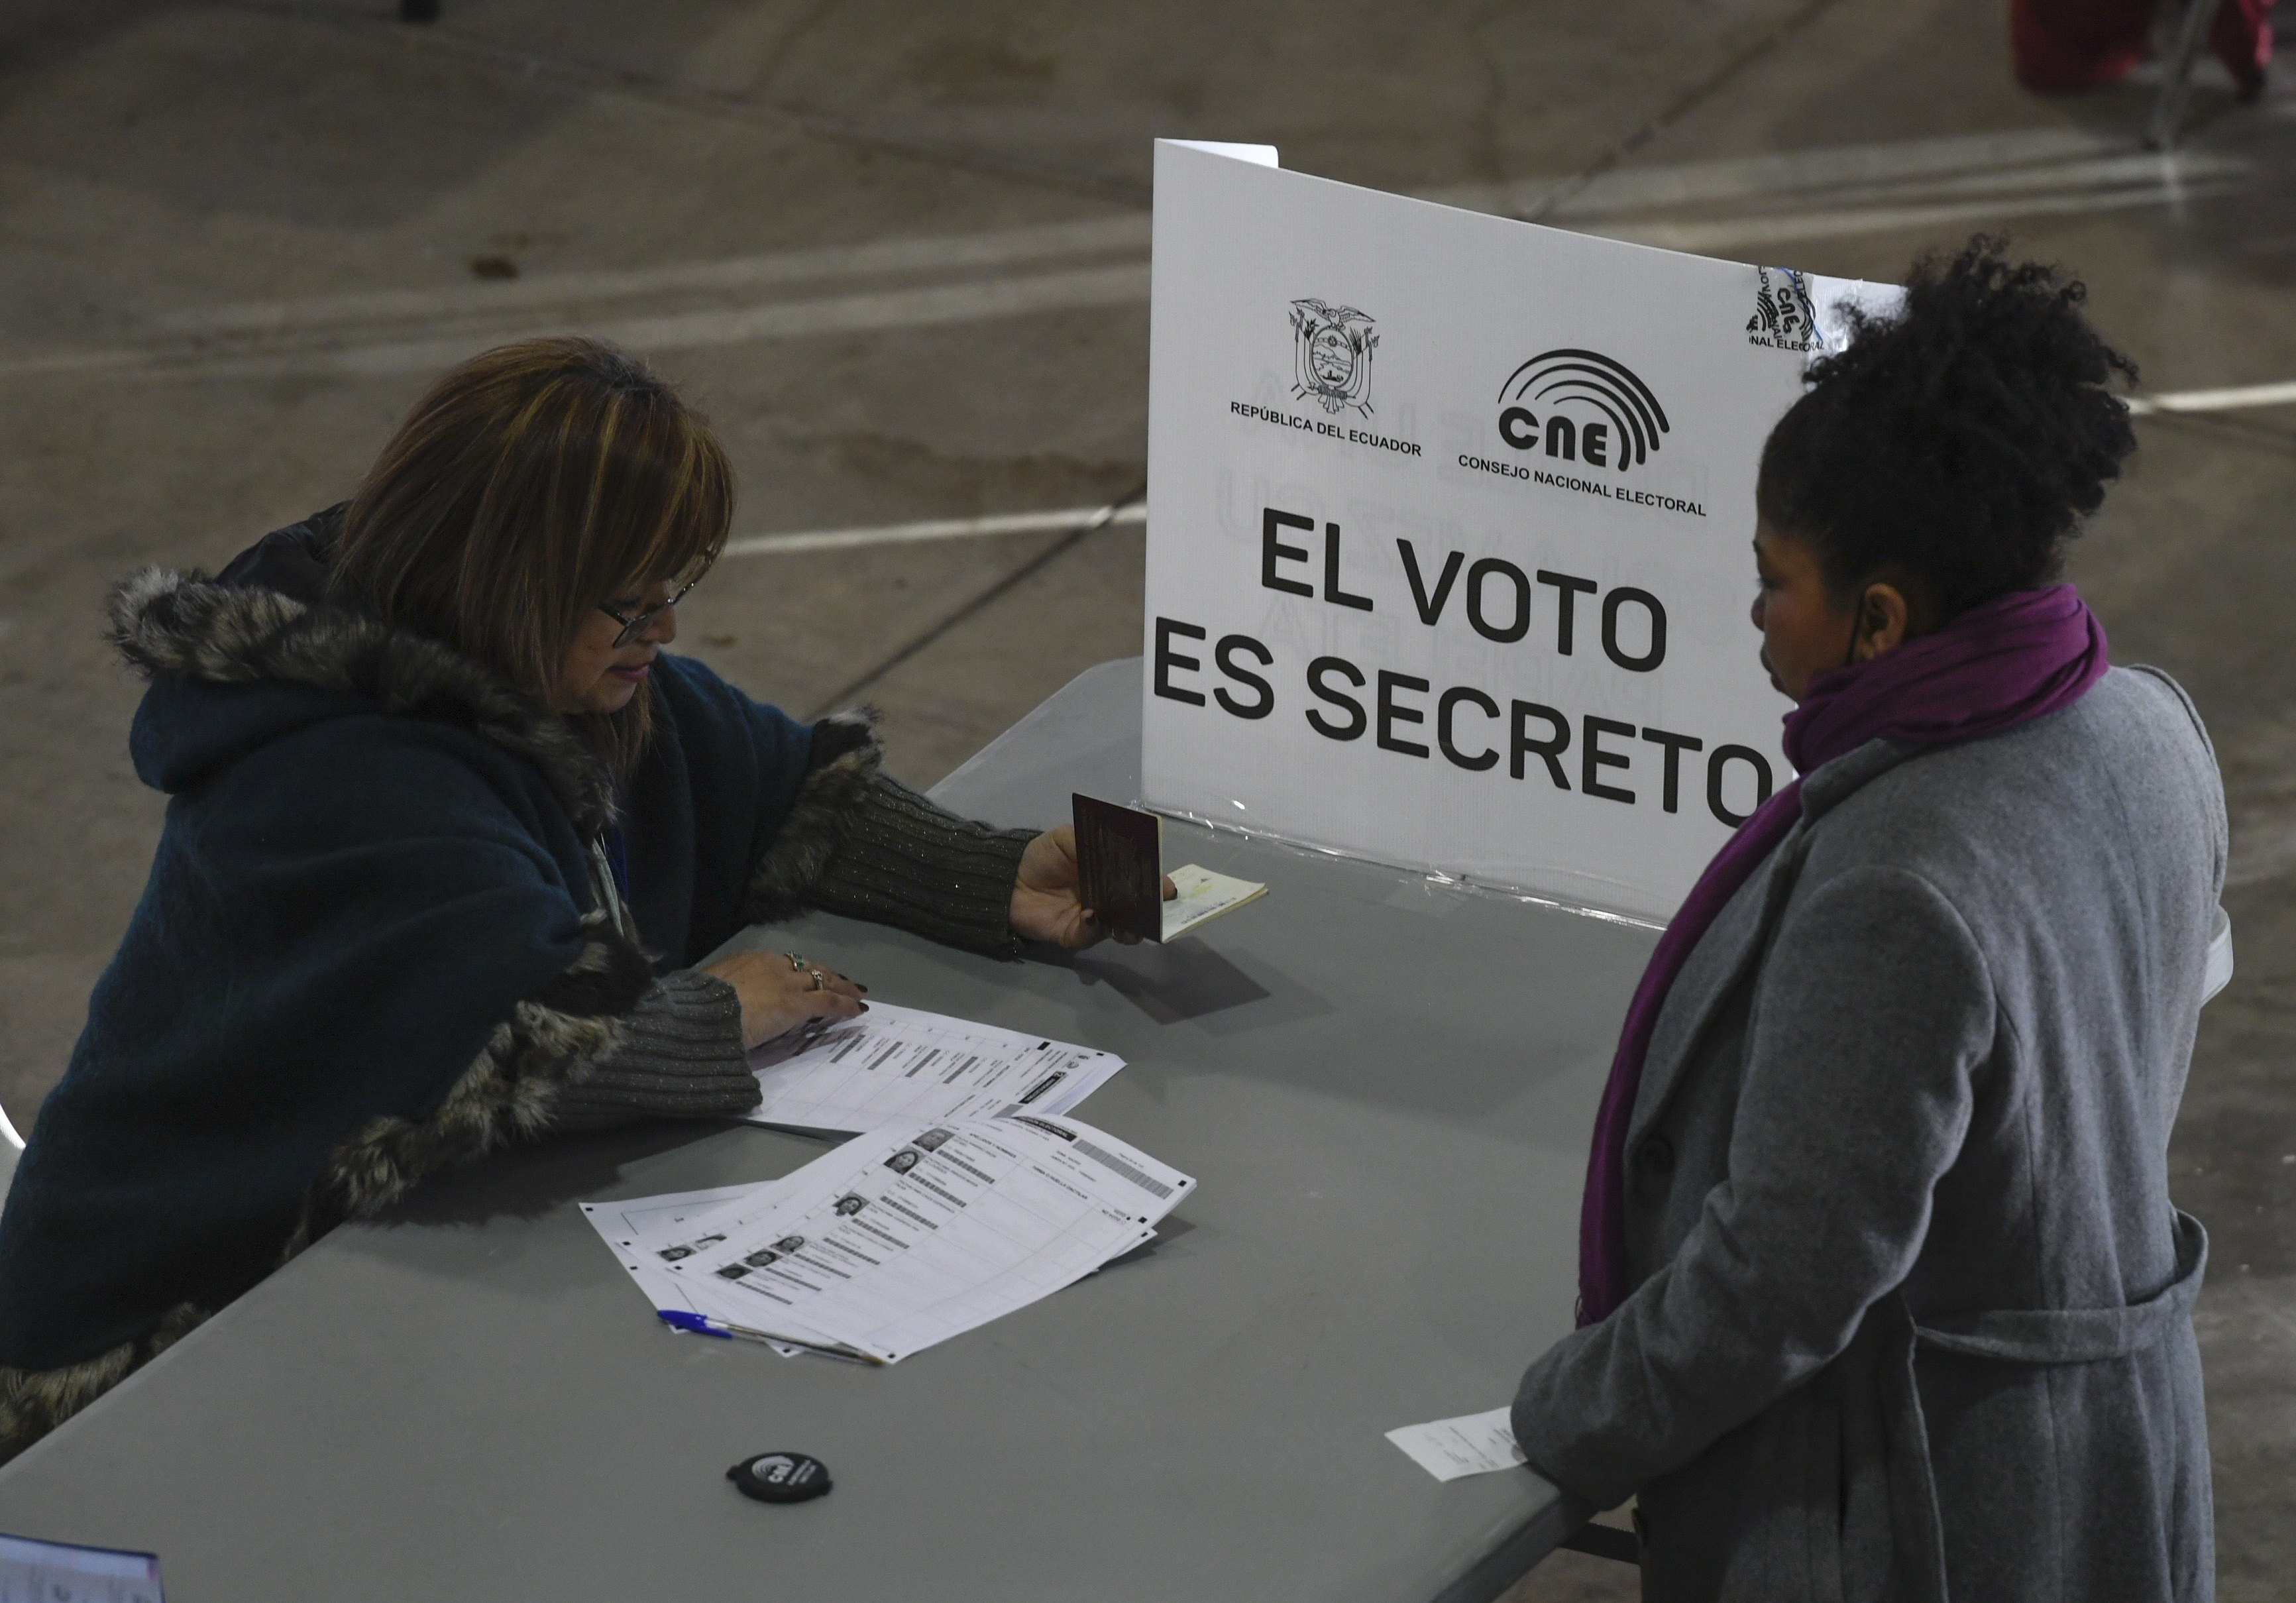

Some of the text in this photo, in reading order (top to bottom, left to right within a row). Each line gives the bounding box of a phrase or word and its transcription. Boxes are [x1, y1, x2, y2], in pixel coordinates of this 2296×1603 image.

[1230, 401, 1421, 457] REPÚBLICA DEL ECUADOR
[1458, 455, 1707, 517] CONSEJO NACIONAL ELECTORAL
[1261, 507, 1667, 673] EL VOTO
[1154, 616, 1774, 828] ES SECRETO
